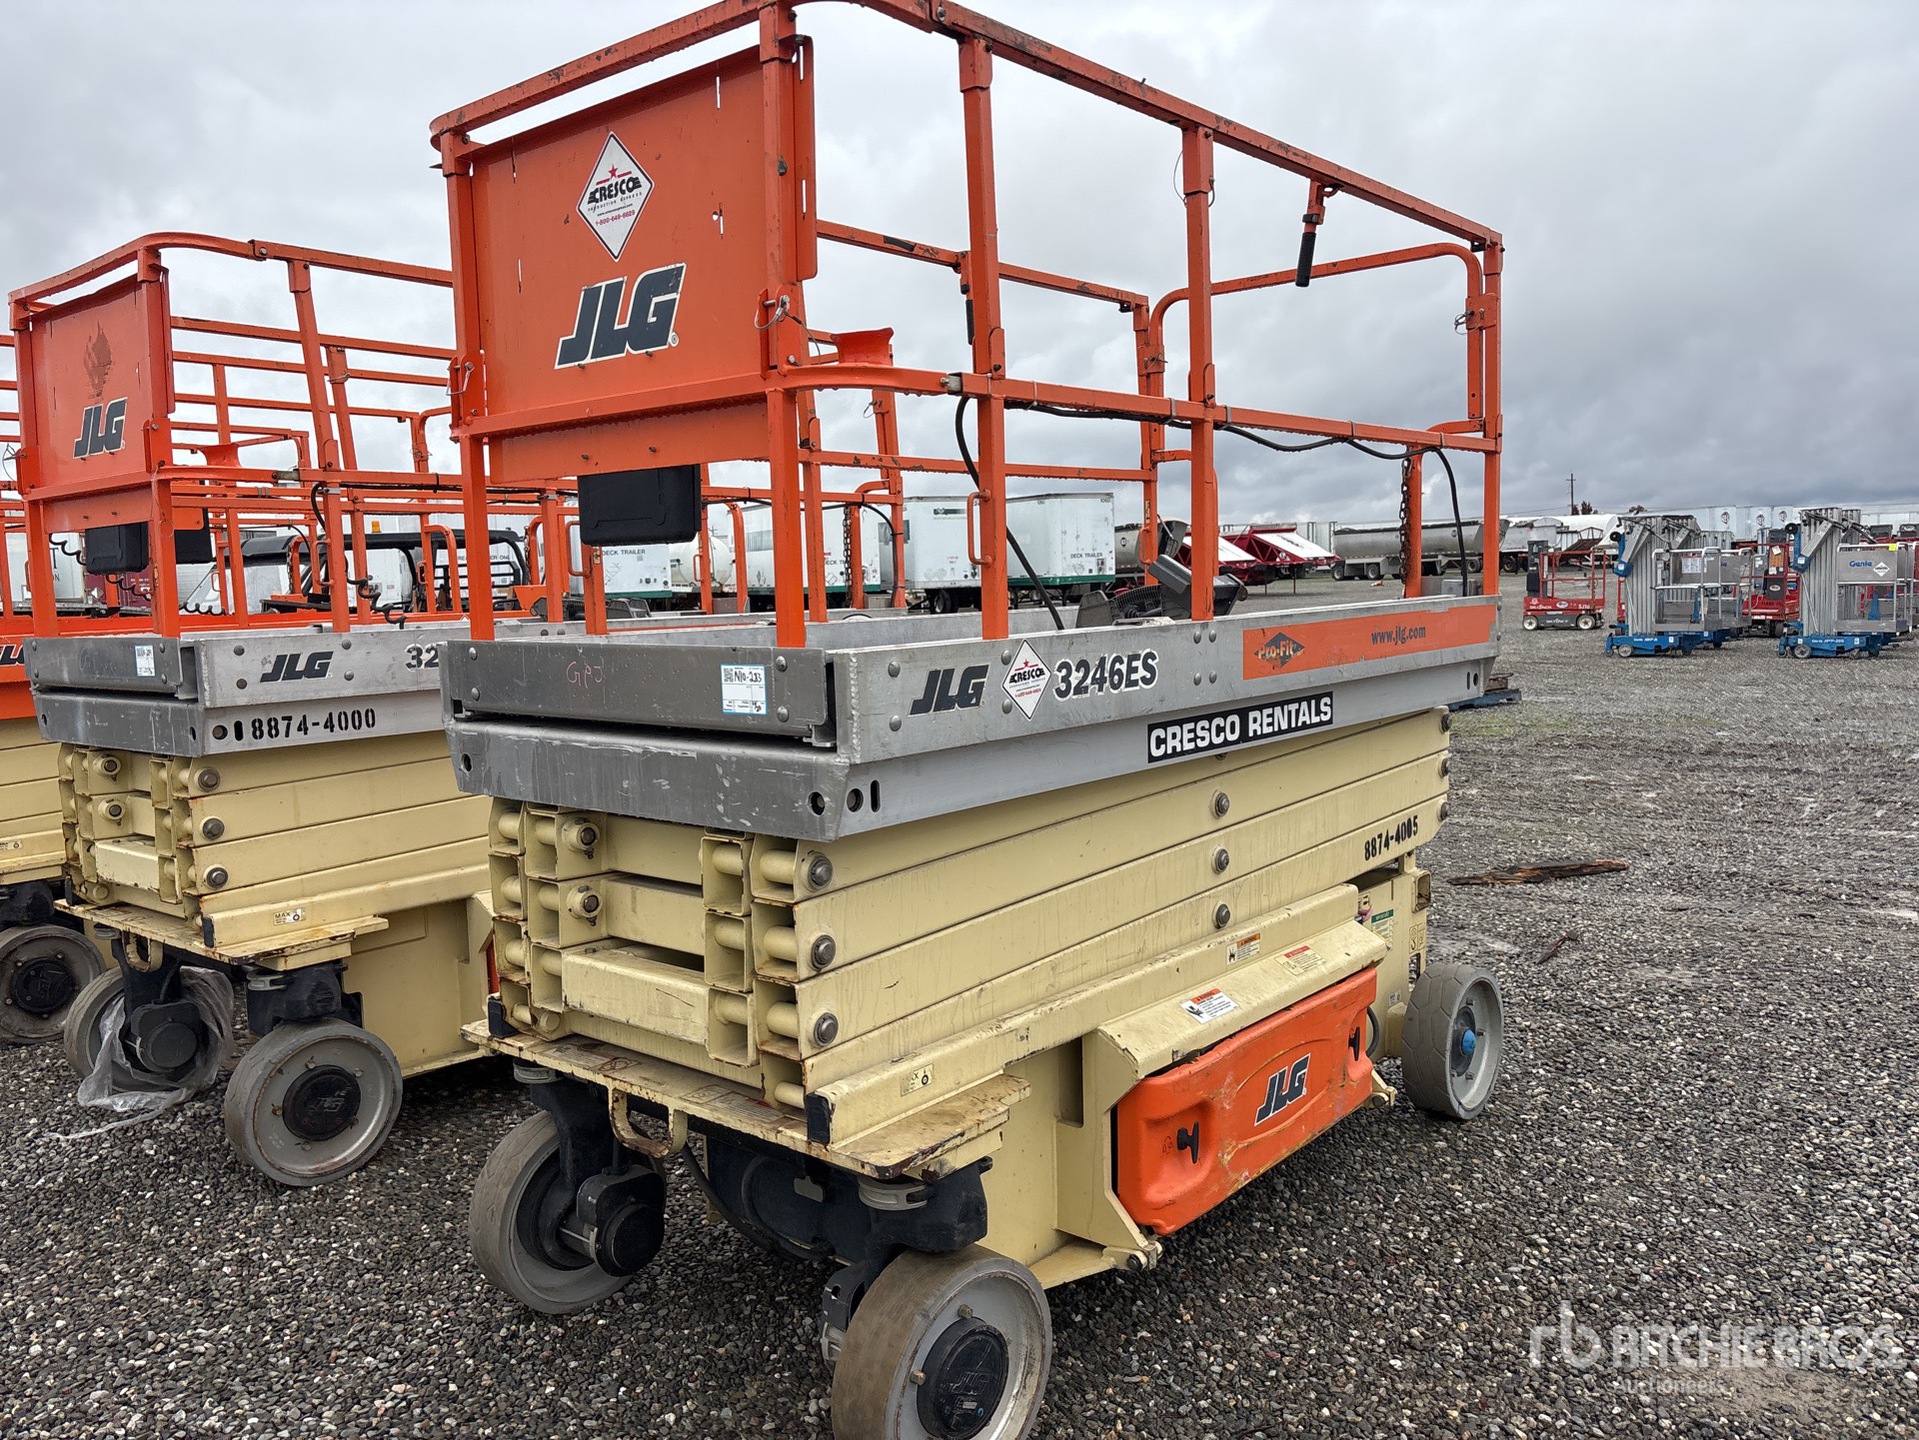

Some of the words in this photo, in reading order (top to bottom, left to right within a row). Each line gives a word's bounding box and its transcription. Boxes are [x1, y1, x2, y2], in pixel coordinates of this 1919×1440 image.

[588, 176, 642, 204] CRESCO
[554, 262, 687, 369] JLG
[73, 397, 128, 459] JLG
[1849, 560, 1873, 568] Genie
[1371, 625, 1426, 645] www.jlg.com
[260, 651, 334, 684] JLG
[1009, 668, 1045, 683] CRESCO
[1053, 649, 1159, 701] 3246ES
[908, 665, 989, 717] JLG
[251, 708, 377, 740] 8874-4000
[1149, 714, 1241, 757] CRESCO
[1248, 695, 1333, 738] RENTALS
[1364, 815, 1418, 861] 8874-4005
[1254, 1053, 1311, 1126] JLG
